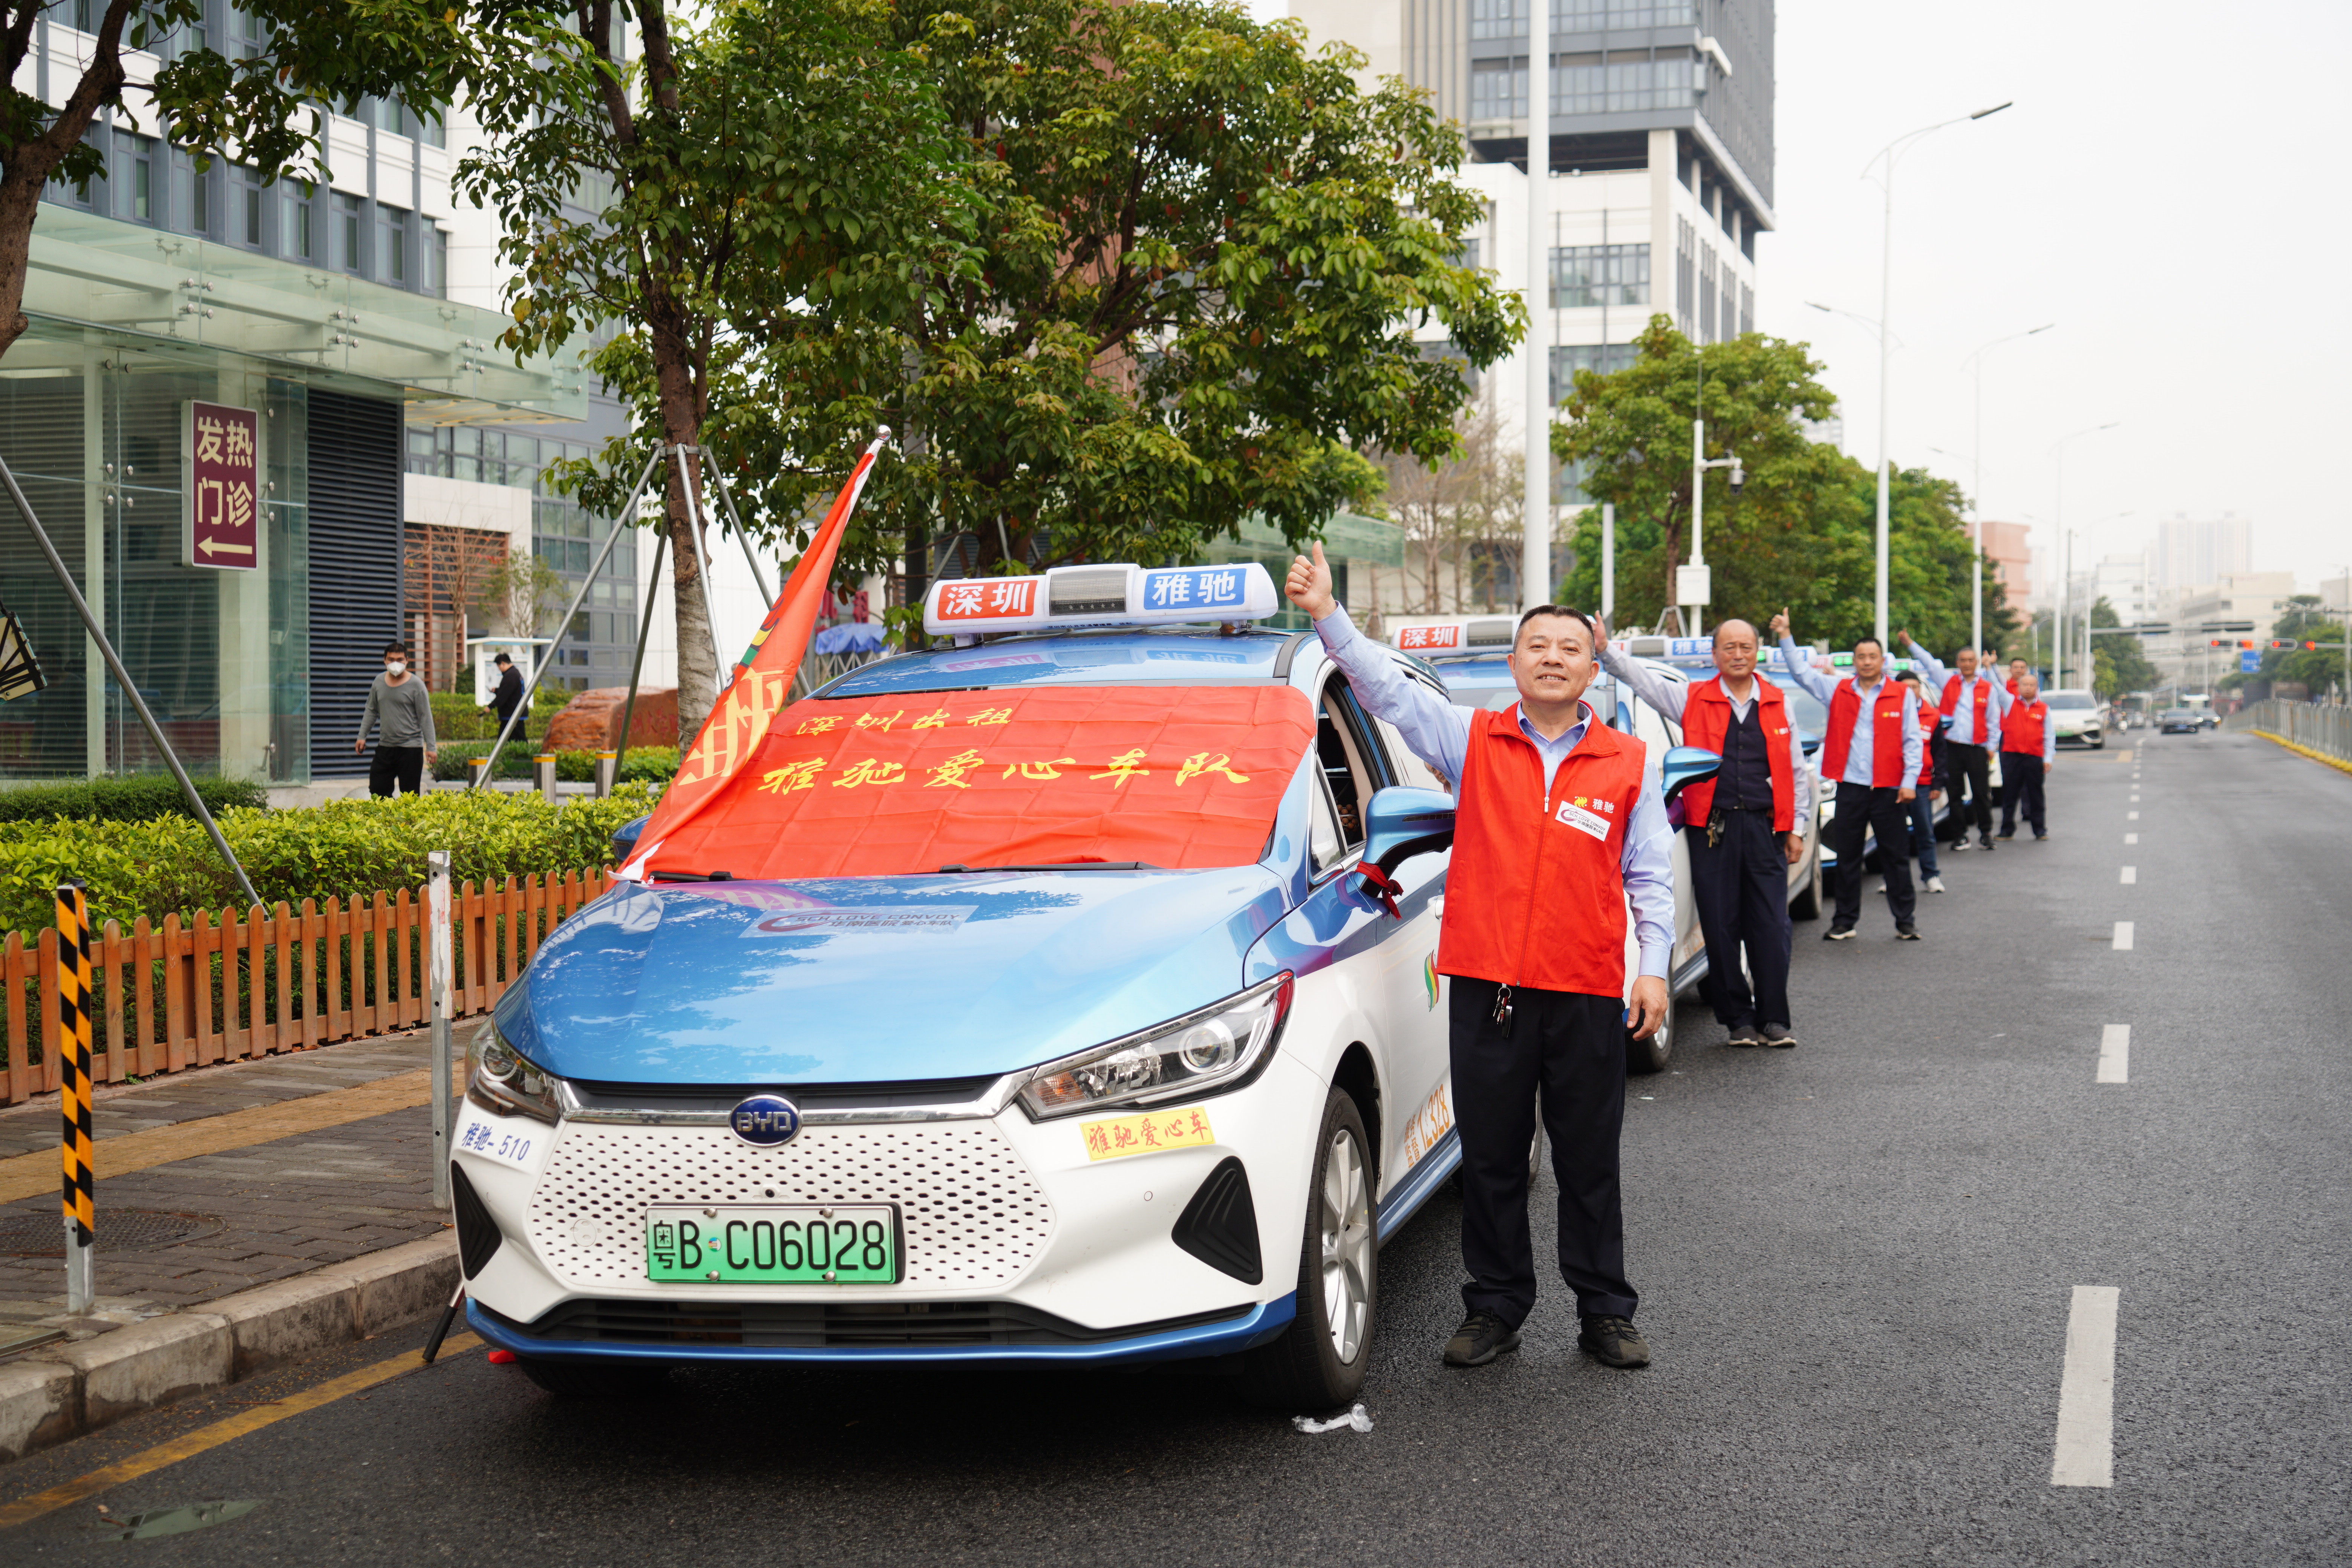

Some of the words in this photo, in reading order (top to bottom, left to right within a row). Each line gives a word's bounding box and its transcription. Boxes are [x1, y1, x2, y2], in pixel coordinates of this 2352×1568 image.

[197, 416, 253, 469] 发热
[198, 476, 253, 528] 门诊
[945, 582, 1030, 616] 深圳
[1152, 571, 1236, 606] 雅驰
[1403, 627, 1456, 647] 深圳
[796, 707, 1013, 736] 深圳出租
[757, 748, 1251, 796] 雅驰爱心车队
[1592, 798, 1614, 813] 雅驰
[1591, 821, 1605, 831] CONVOY
[737, 1112, 792, 1132] BYD
[1089, 1110, 1208, 1155] 雅驰爱心车
[1320, 1133, 1332, 1197] RADIAL
